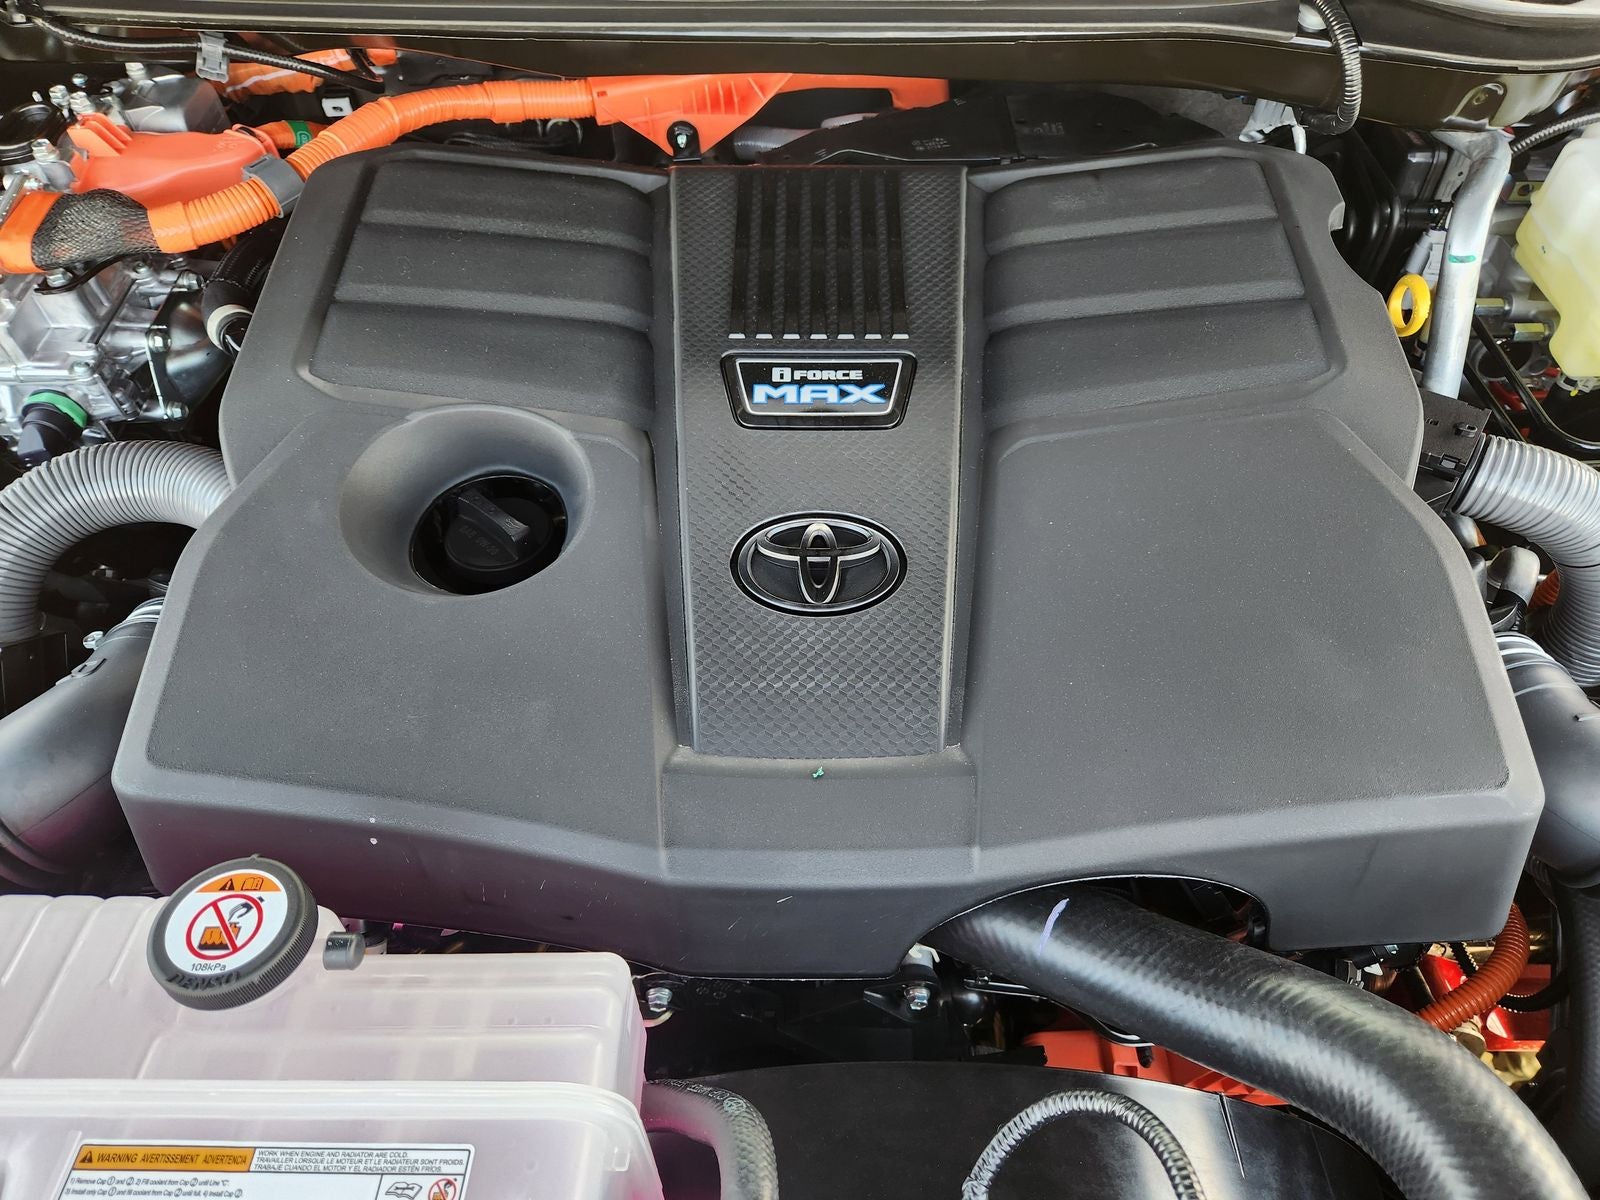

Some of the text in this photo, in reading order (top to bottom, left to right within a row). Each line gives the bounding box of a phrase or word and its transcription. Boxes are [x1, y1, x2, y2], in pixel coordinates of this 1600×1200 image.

[751, 383, 887, 405] MAX
[190, 963, 226, 972] 108kPa
[97, 1152, 247, 1165] WARNING AVERTISSEMENT ADVERTENCIA
[294, 1157, 325, 1165] LORSQUE
[284, 1164, 312, 1172] CUANDO
[96, 1178, 106, 1186] Cap
